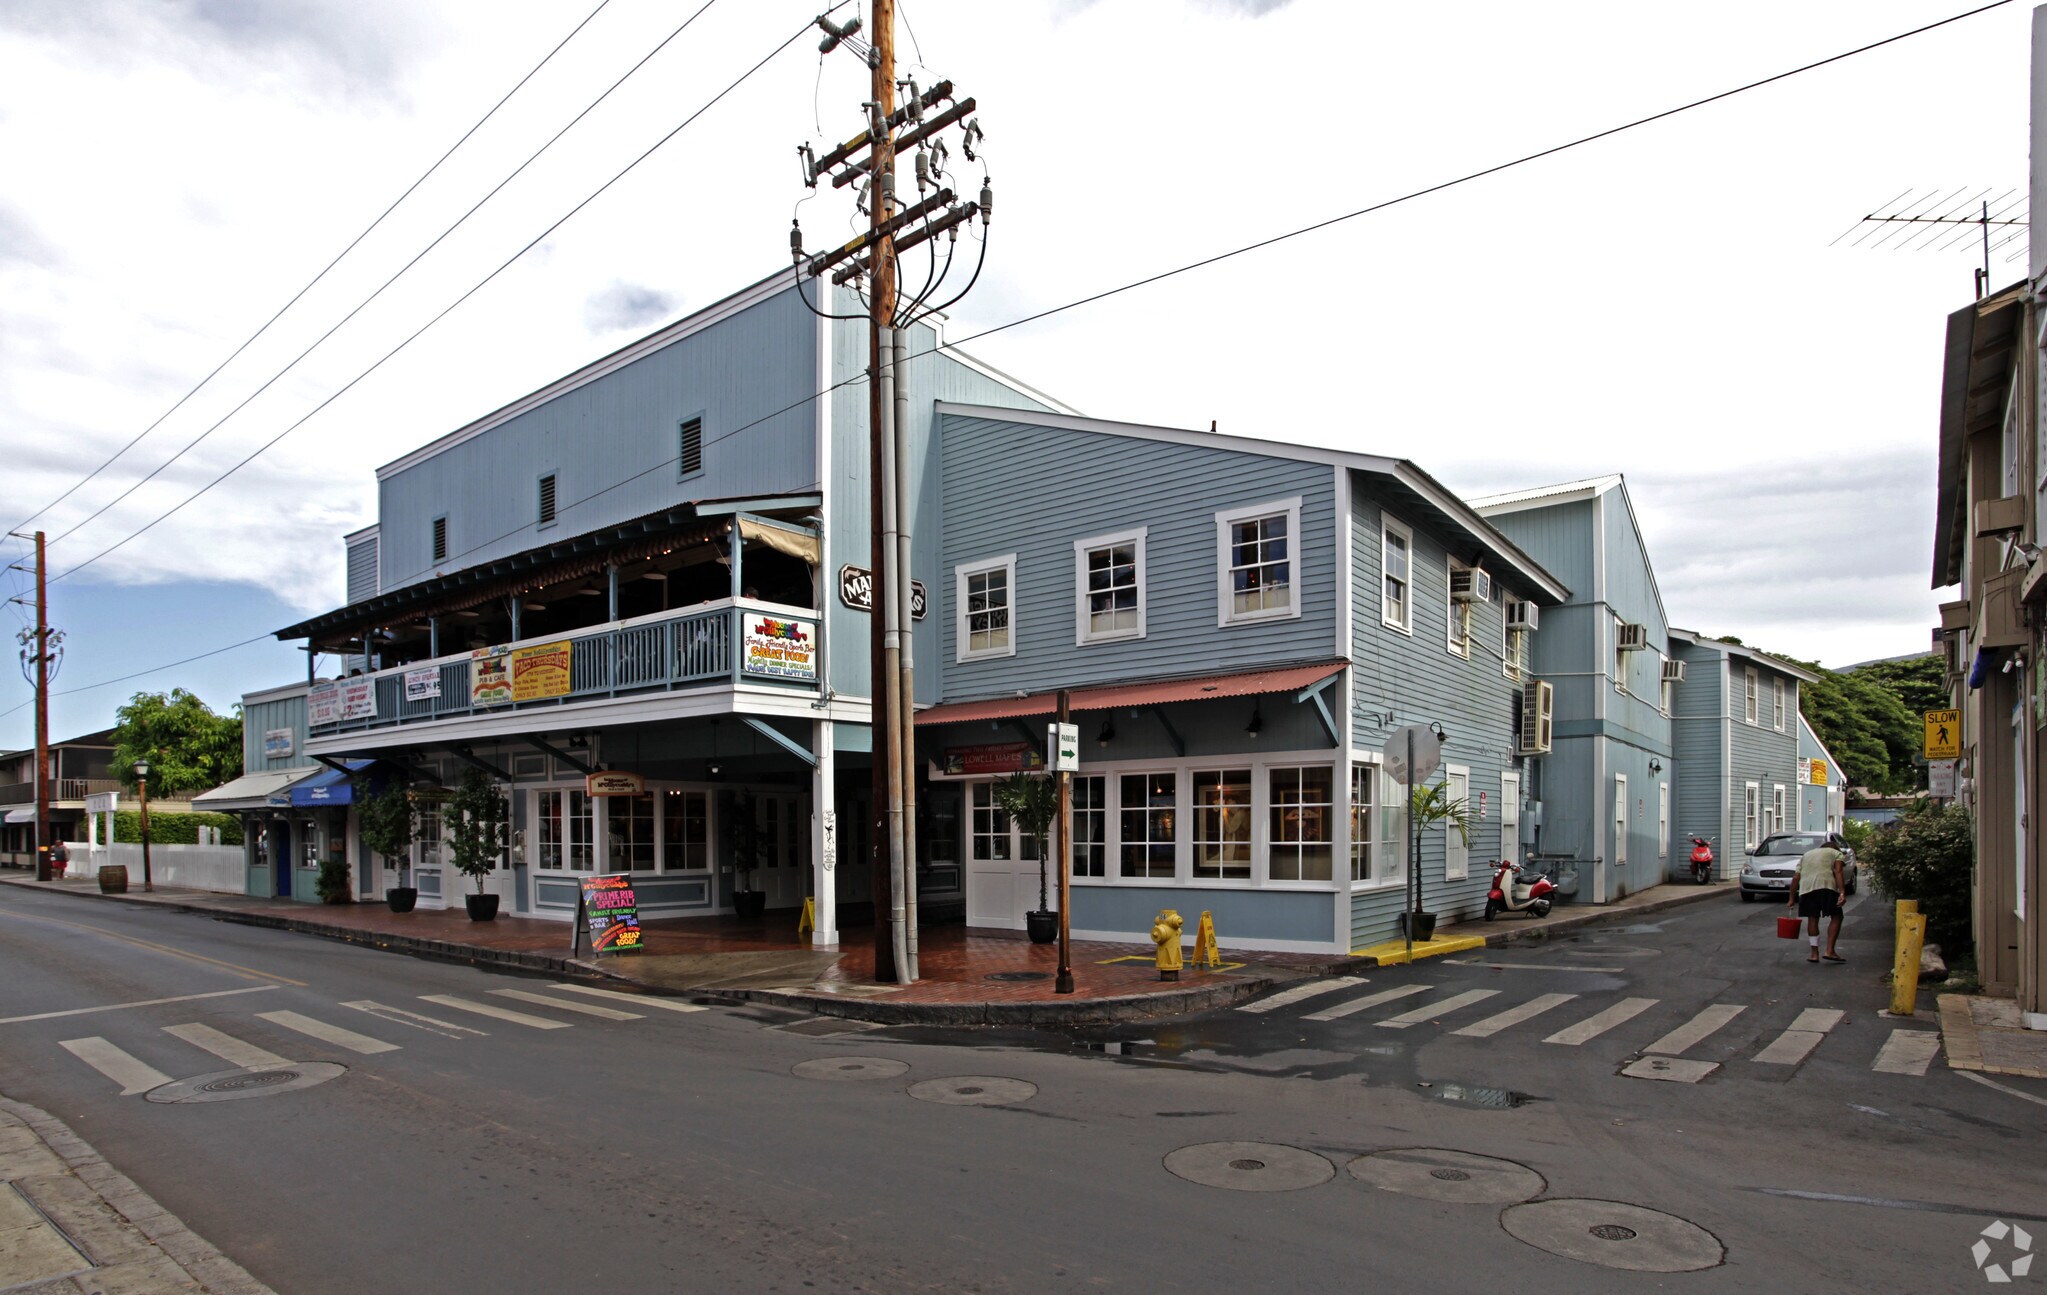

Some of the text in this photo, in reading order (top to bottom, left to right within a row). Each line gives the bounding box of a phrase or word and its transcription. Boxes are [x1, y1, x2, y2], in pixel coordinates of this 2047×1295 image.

[765, 638, 788, 650] Friendly
[788, 641, 804, 652] Sports
[804, 643, 815, 653] Bar
[751, 646, 809, 664] GREAT FOOD!
[515, 659, 532, 676] TACO
[532, 653, 568, 671] THURSDAYS
[747, 656, 768, 667] Nightly
[1928, 712, 1957, 724] SLOW
[1061, 734, 1077, 743] PARKING
[965, 754, 994, 764] LOWELL
[593, 890, 634, 901] PRIME RIB
[596, 898, 635, 909] SPECIAL!
[589, 909, 611, 917] FAMILY
[619, 931, 641, 939] GREAT
[616, 938, 636, 947] FOOD!
